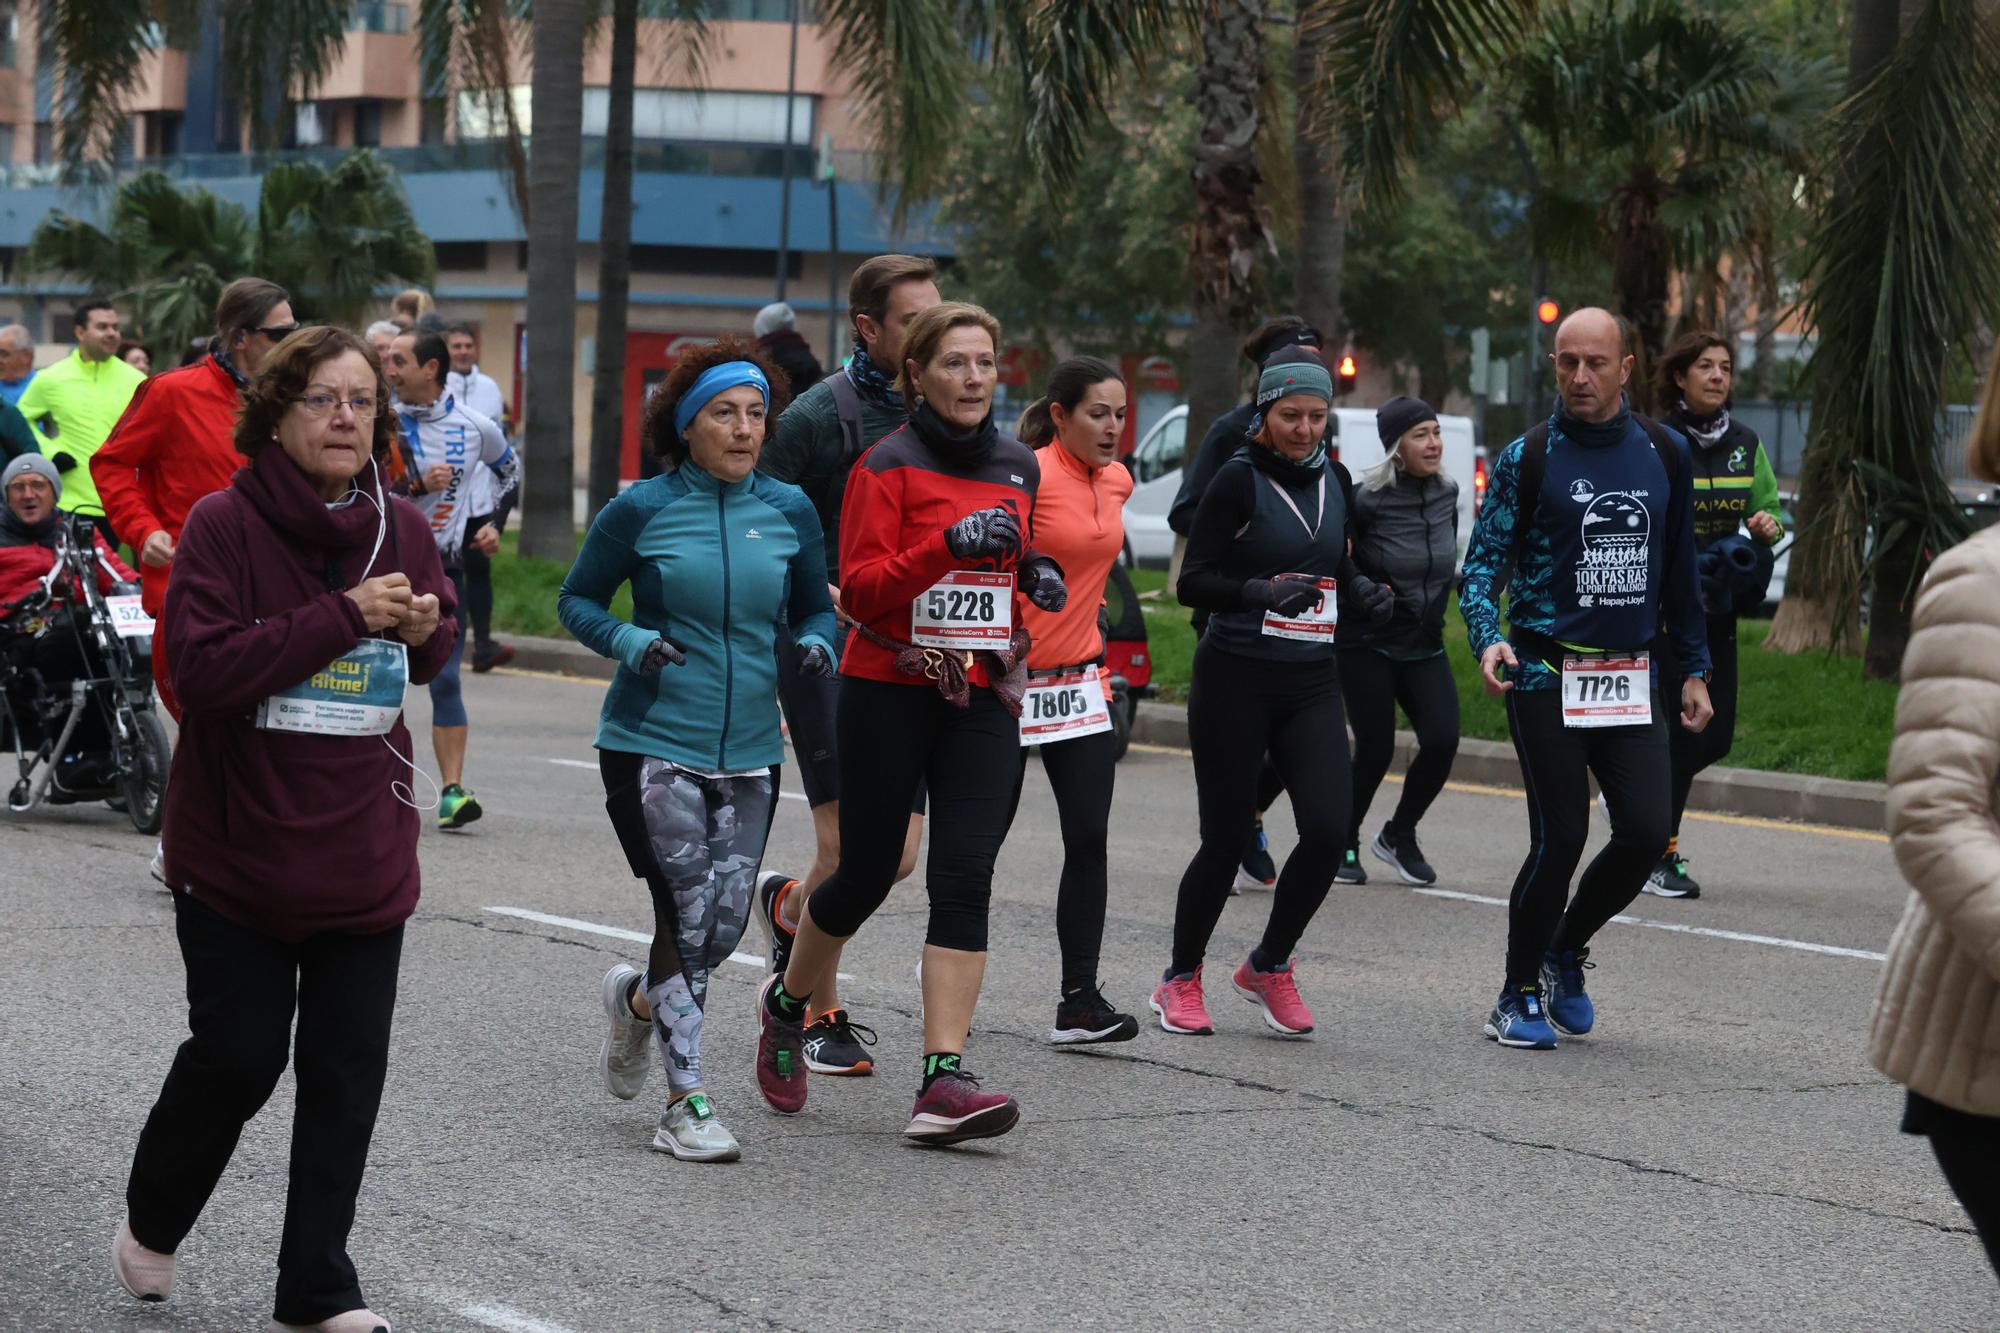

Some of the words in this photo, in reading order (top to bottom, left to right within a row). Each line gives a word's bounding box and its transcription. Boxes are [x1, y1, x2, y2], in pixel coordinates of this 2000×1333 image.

[1574, 570, 1600, 586] 10K
[1601, 569, 1626, 585] PAS
[1627, 568, 1648, 584] RAS
[1576, 584, 1586, 594] AL
[1586, 584, 1607, 594] PORT
[1607, 584, 1617, 593] DE
[928, 590, 995, 622] 5228
[1599, 595, 1646, 607] Hapag-Lloyd
[1577, 675, 1631, 702] 7726
[1029, 689, 1088, 719] 7805
